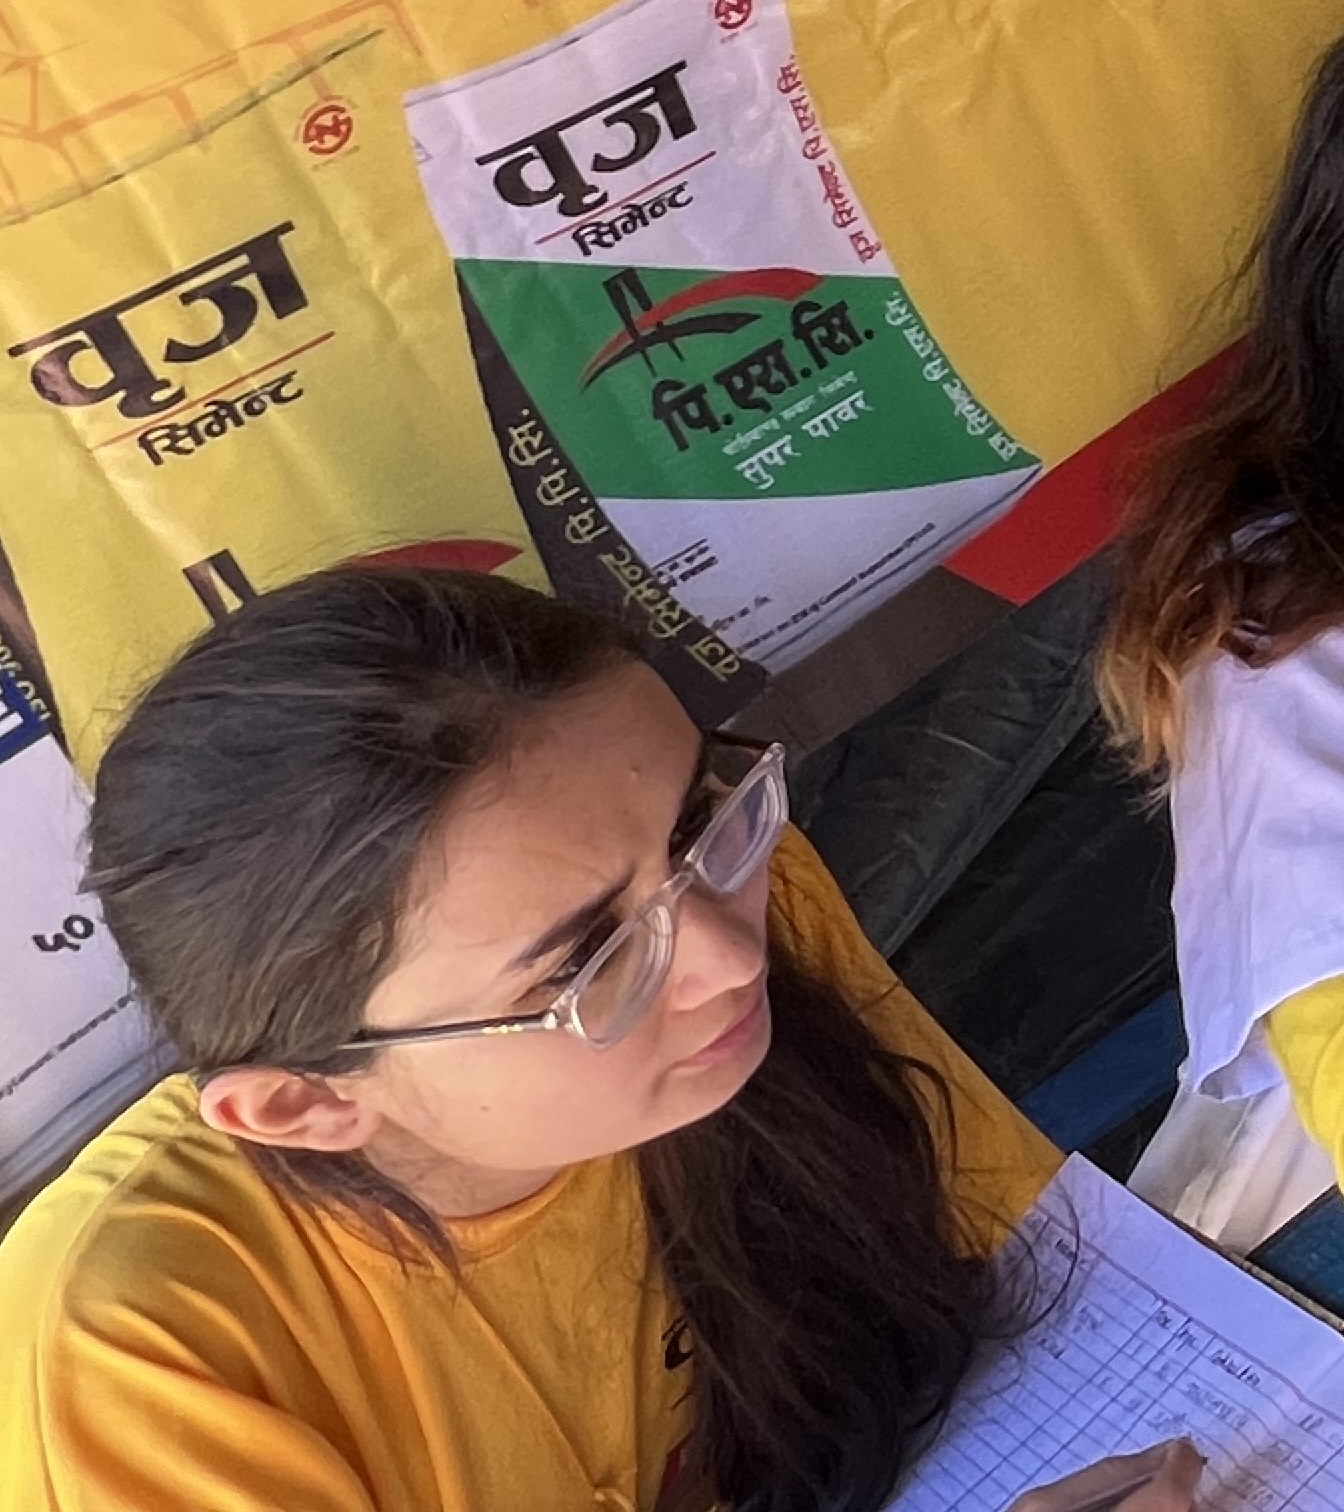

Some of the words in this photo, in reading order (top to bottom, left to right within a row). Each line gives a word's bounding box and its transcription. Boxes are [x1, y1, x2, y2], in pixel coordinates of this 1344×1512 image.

[475, 60, 697, 218] वृज
[572, 181, 694, 257] सिमेन्ट
[8, 220, 310, 421] वृज
[138, 368, 304, 466] सिमेन्ट
[735, 434, 802, 490] सुपर
[801, 390, 875, 438] पावर
